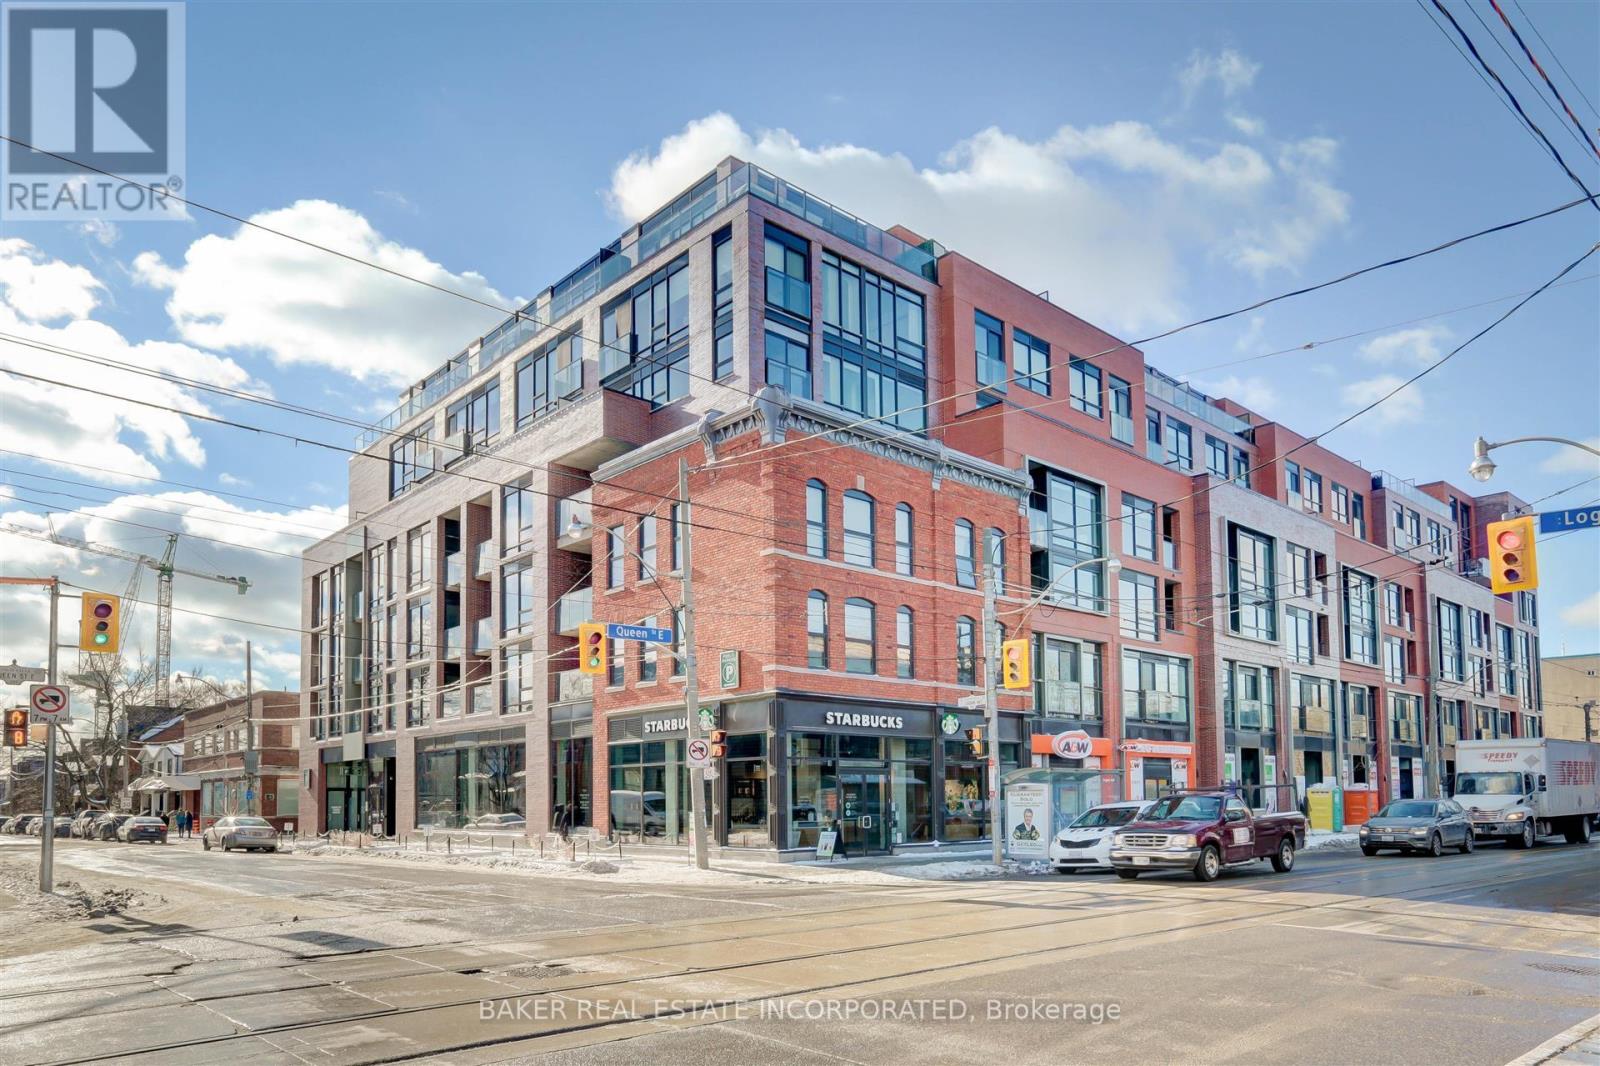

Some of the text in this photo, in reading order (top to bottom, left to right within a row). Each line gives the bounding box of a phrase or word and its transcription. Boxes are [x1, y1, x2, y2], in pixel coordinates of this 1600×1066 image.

[616, 625, 648, 639] Queen
[658, 630, 664, 640] E
[33, 714, 39, 722] 7
[53, 714, 58, 722] 7
[644, 717, 690, 734] STARBU
[825, 711, 903, 729] STARBUCKS
[1062, 741, 1089, 754] A&W
[1483, 751, 1519, 760] SPEEDY
[1558, 759, 1596, 786] SPEEDY
